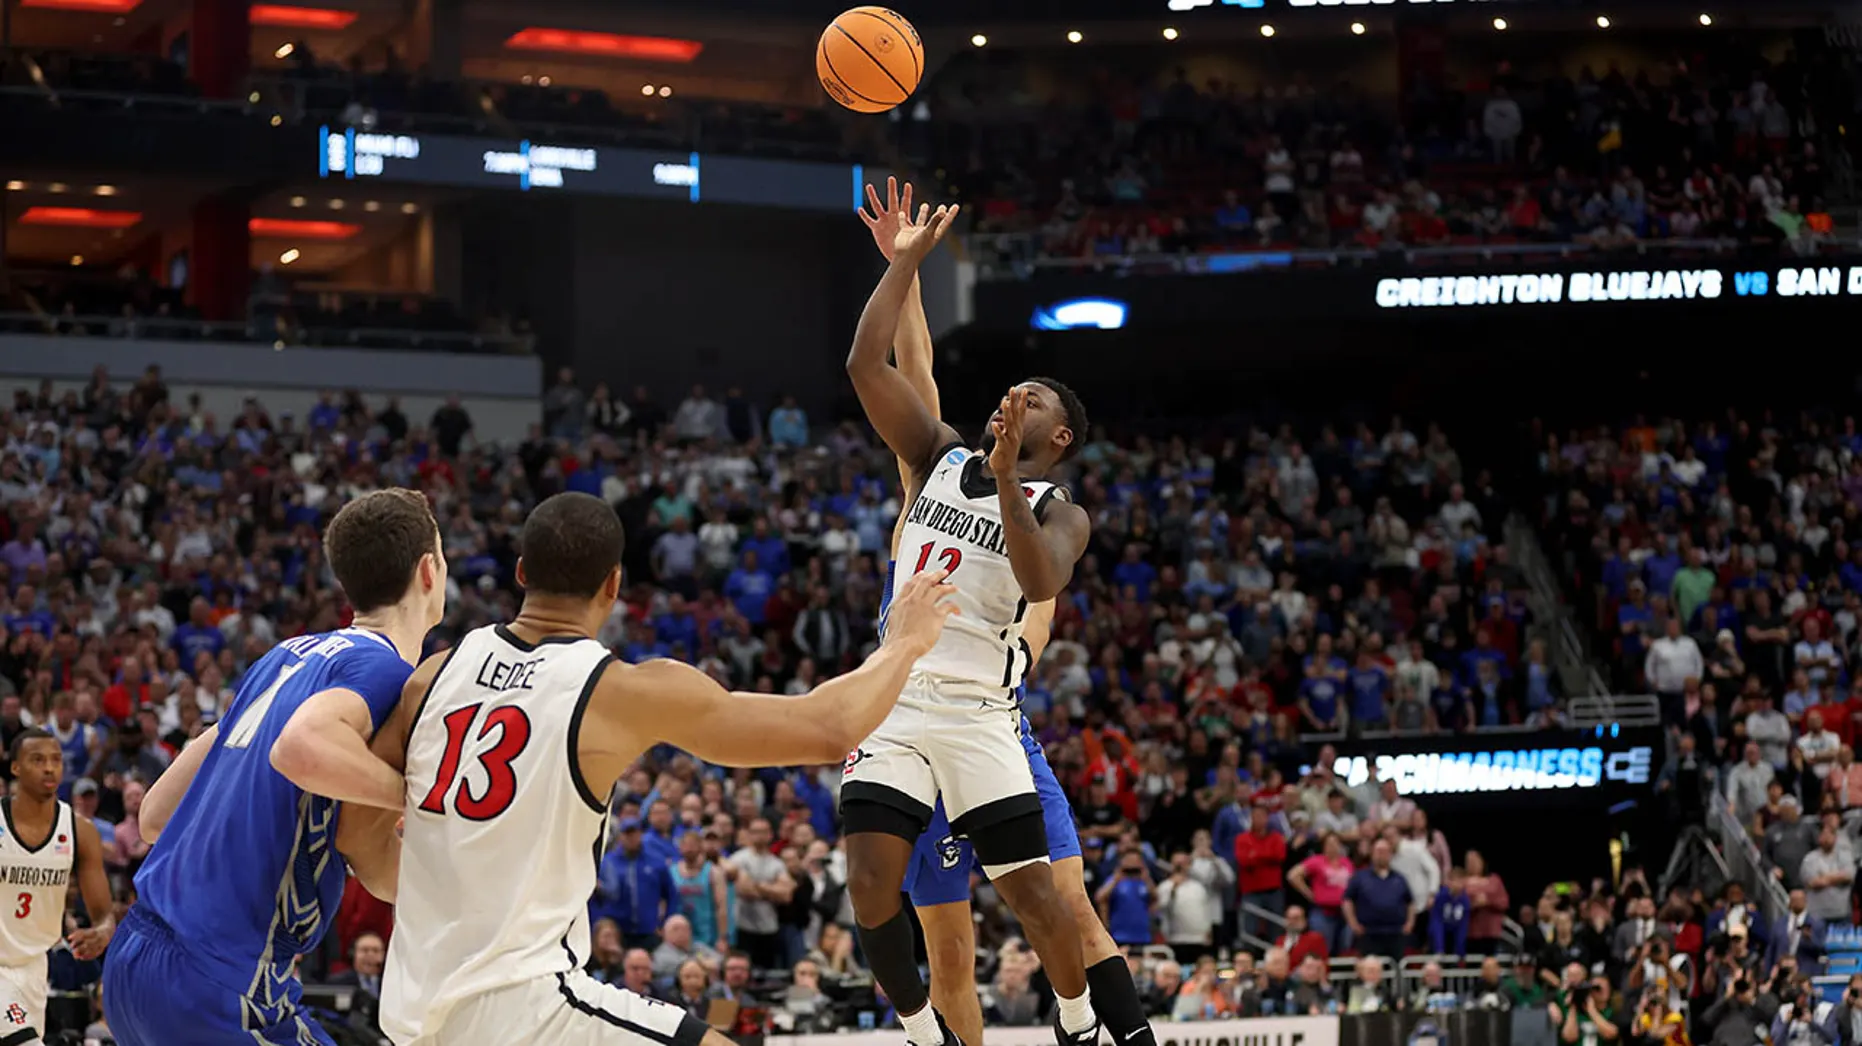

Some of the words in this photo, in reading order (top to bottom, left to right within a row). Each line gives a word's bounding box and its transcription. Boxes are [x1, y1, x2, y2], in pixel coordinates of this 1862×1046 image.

[1376, 272, 1563, 308] CREIGHTON
[1568, 269, 1723, 302] BLUEJAYS
[1734, 271, 1769, 296] VS
[1776, 267, 1841, 296] SAN
[926, 501, 974, 540] DIEGO
[914, 540, 962, 585] 12
[418, 702, 532, 821] 13
[8, 866, 40, 887] DIEGO
[15, 891, 33, 919] 3
